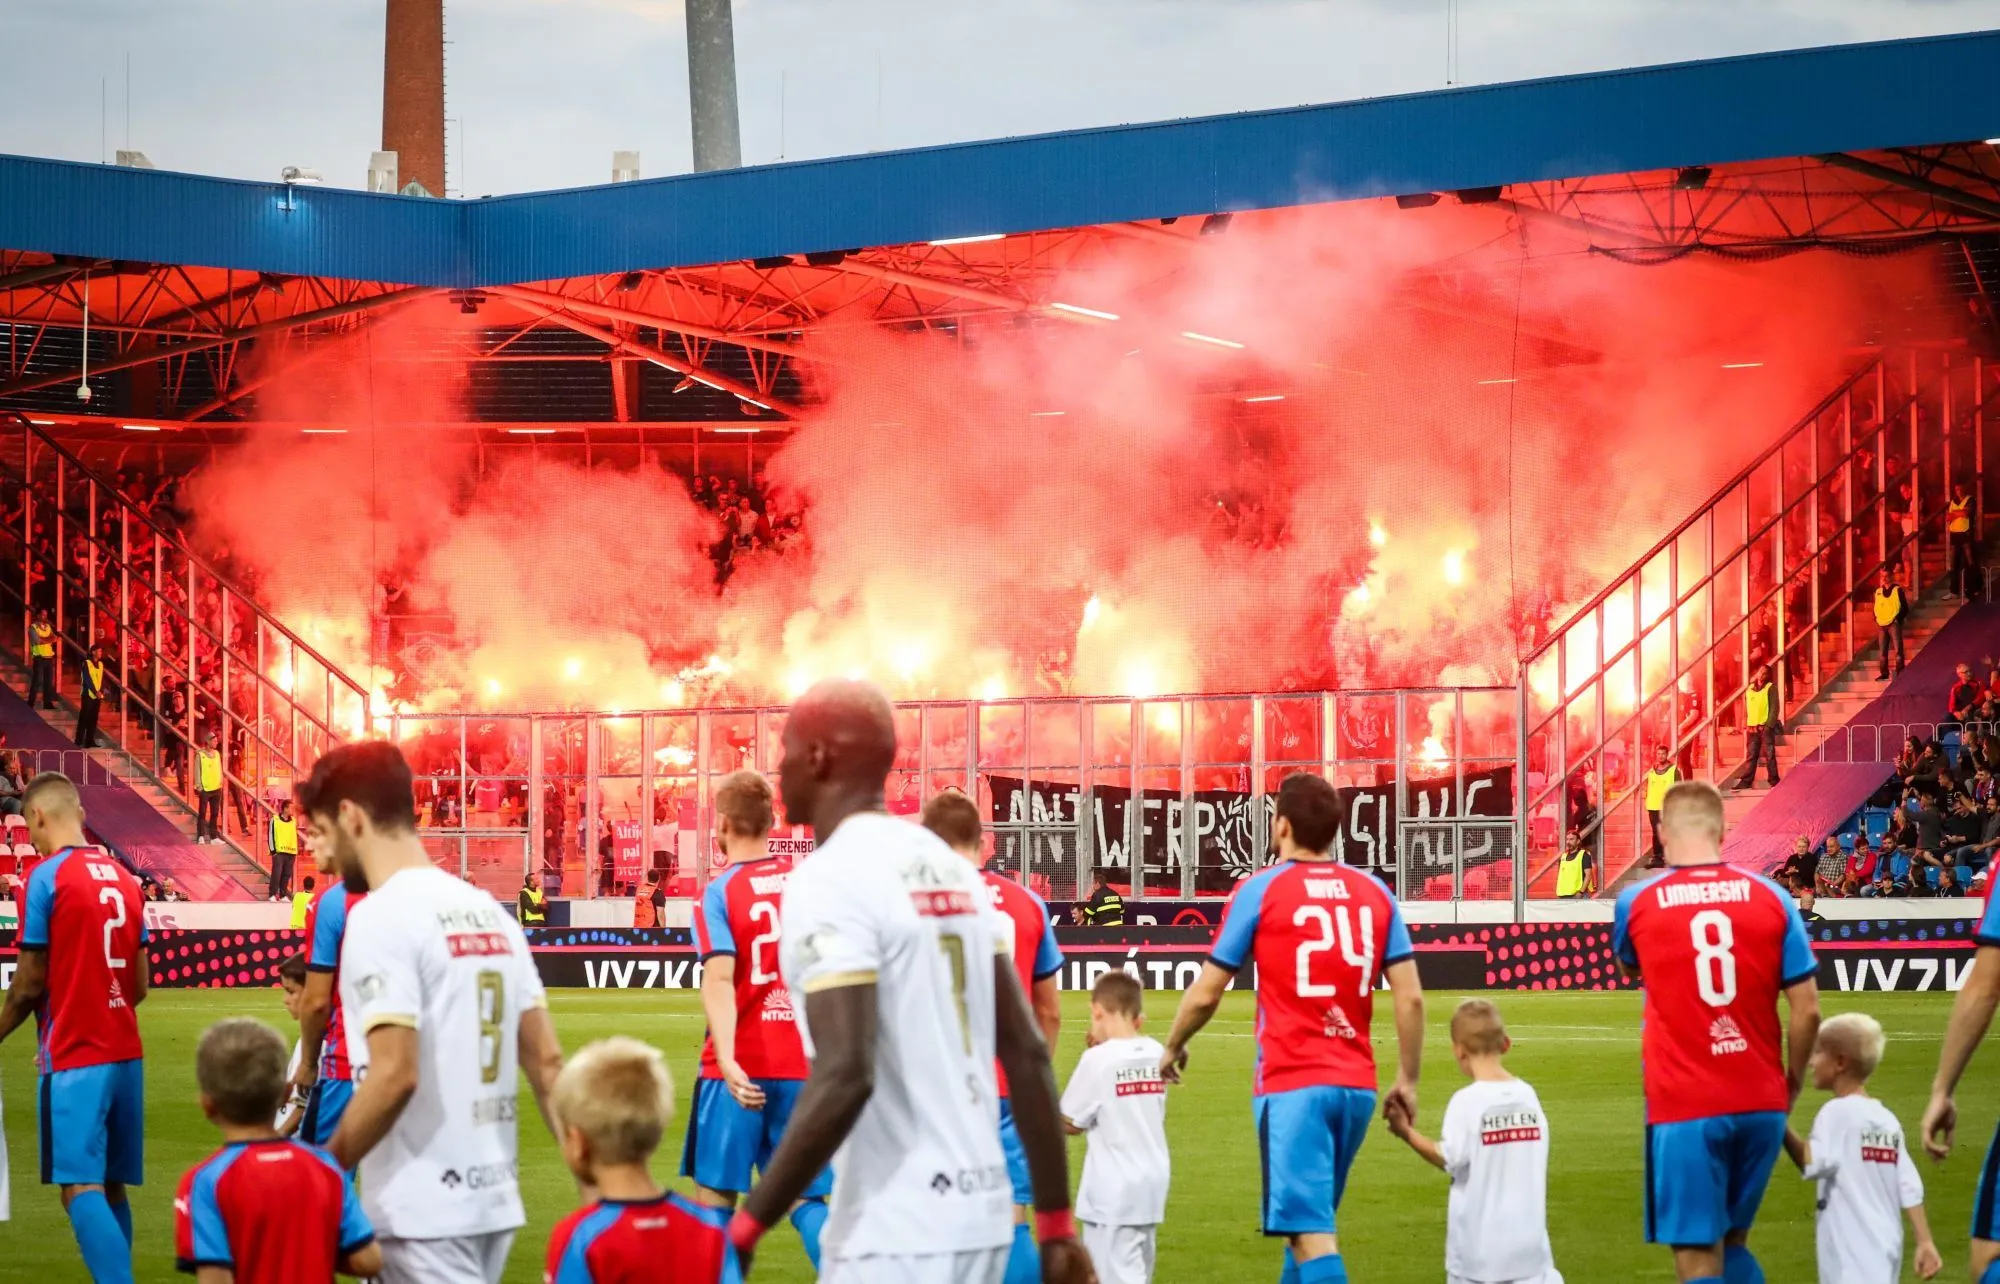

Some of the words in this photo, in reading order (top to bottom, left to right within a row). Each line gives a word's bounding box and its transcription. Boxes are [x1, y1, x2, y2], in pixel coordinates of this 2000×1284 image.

[99, 887, 127, 969] 2
[1292, 905, 1375, 997] 24
[1689, 909, 1737, 1008] 8
[1116, 1066, 1161, 1080] HEYLE
[1482, 1113, 1538, 1129] HEYLEN
